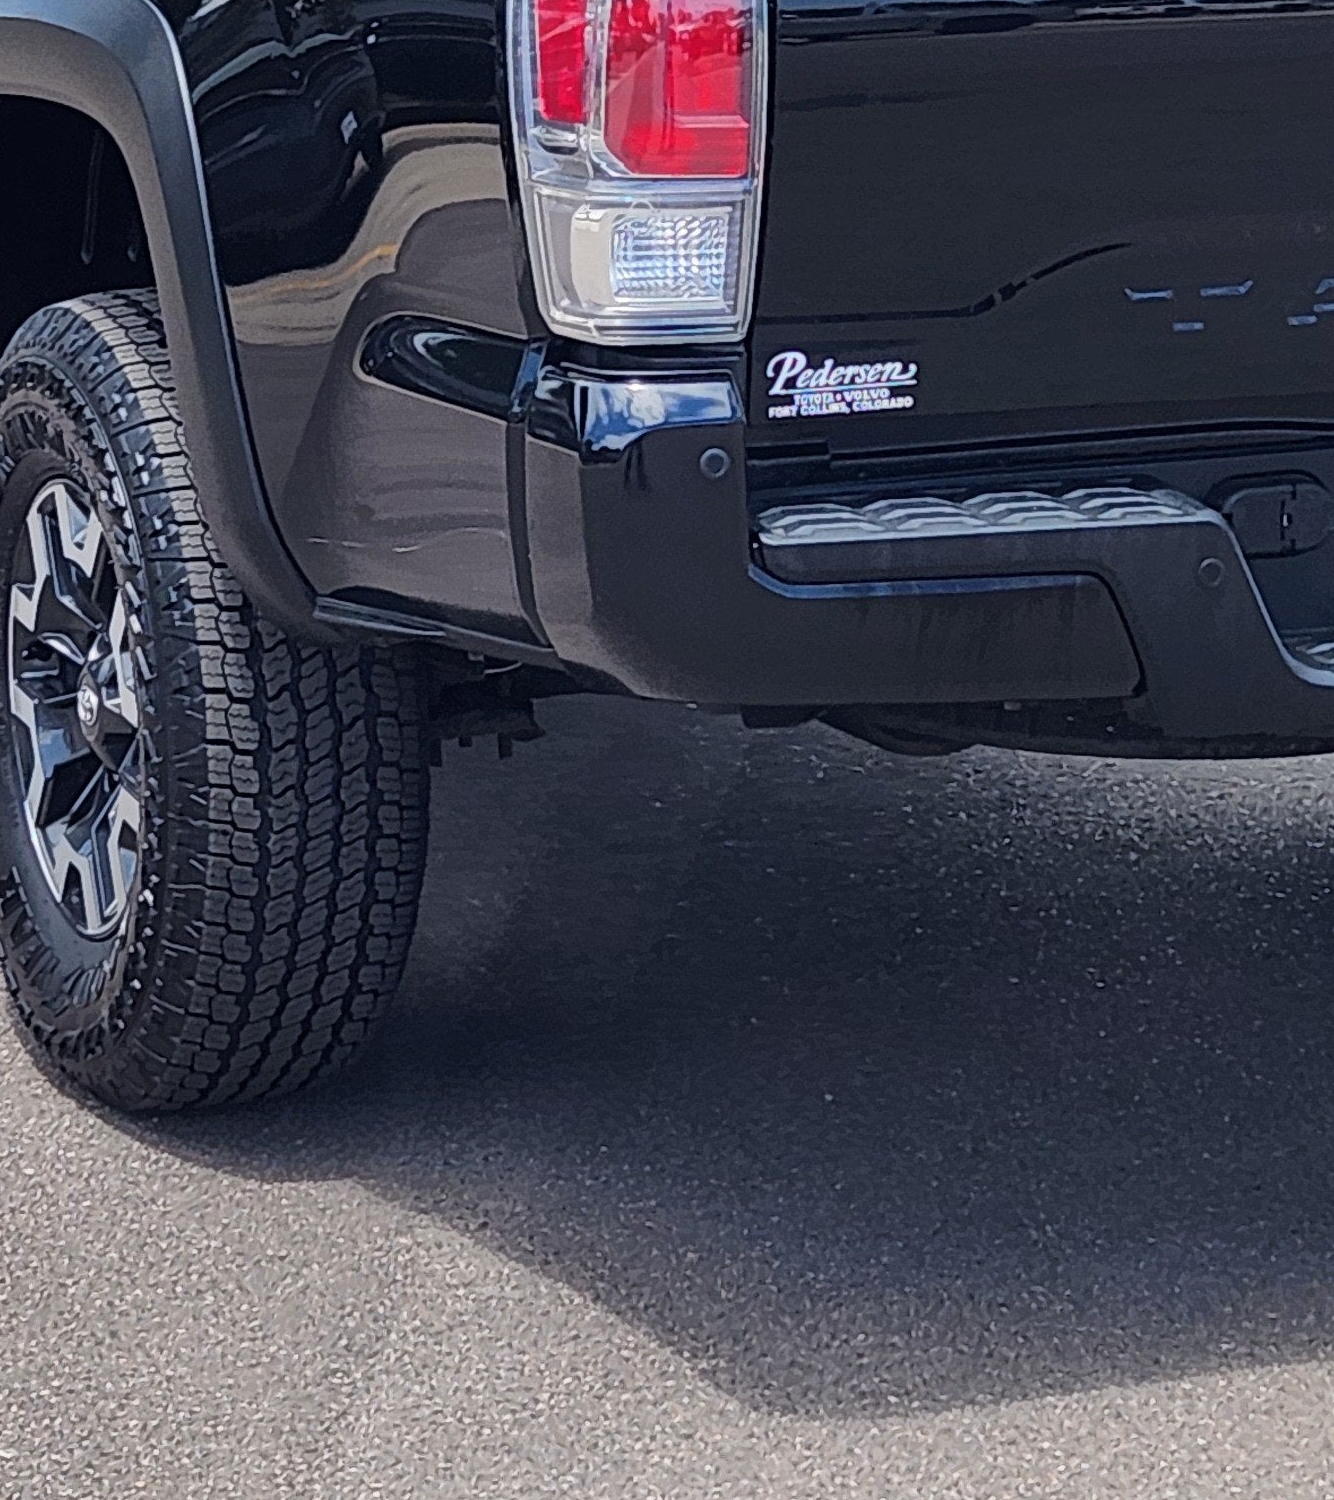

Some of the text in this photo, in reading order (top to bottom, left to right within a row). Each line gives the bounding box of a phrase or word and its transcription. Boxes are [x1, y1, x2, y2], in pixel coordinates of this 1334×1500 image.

[766, 350, 918, 395] Pedersen
[843, 388, 891, 402] VOLVO
[768, 404, 799, 419] FORT
[851, 396, 915, 413] COLORADO
